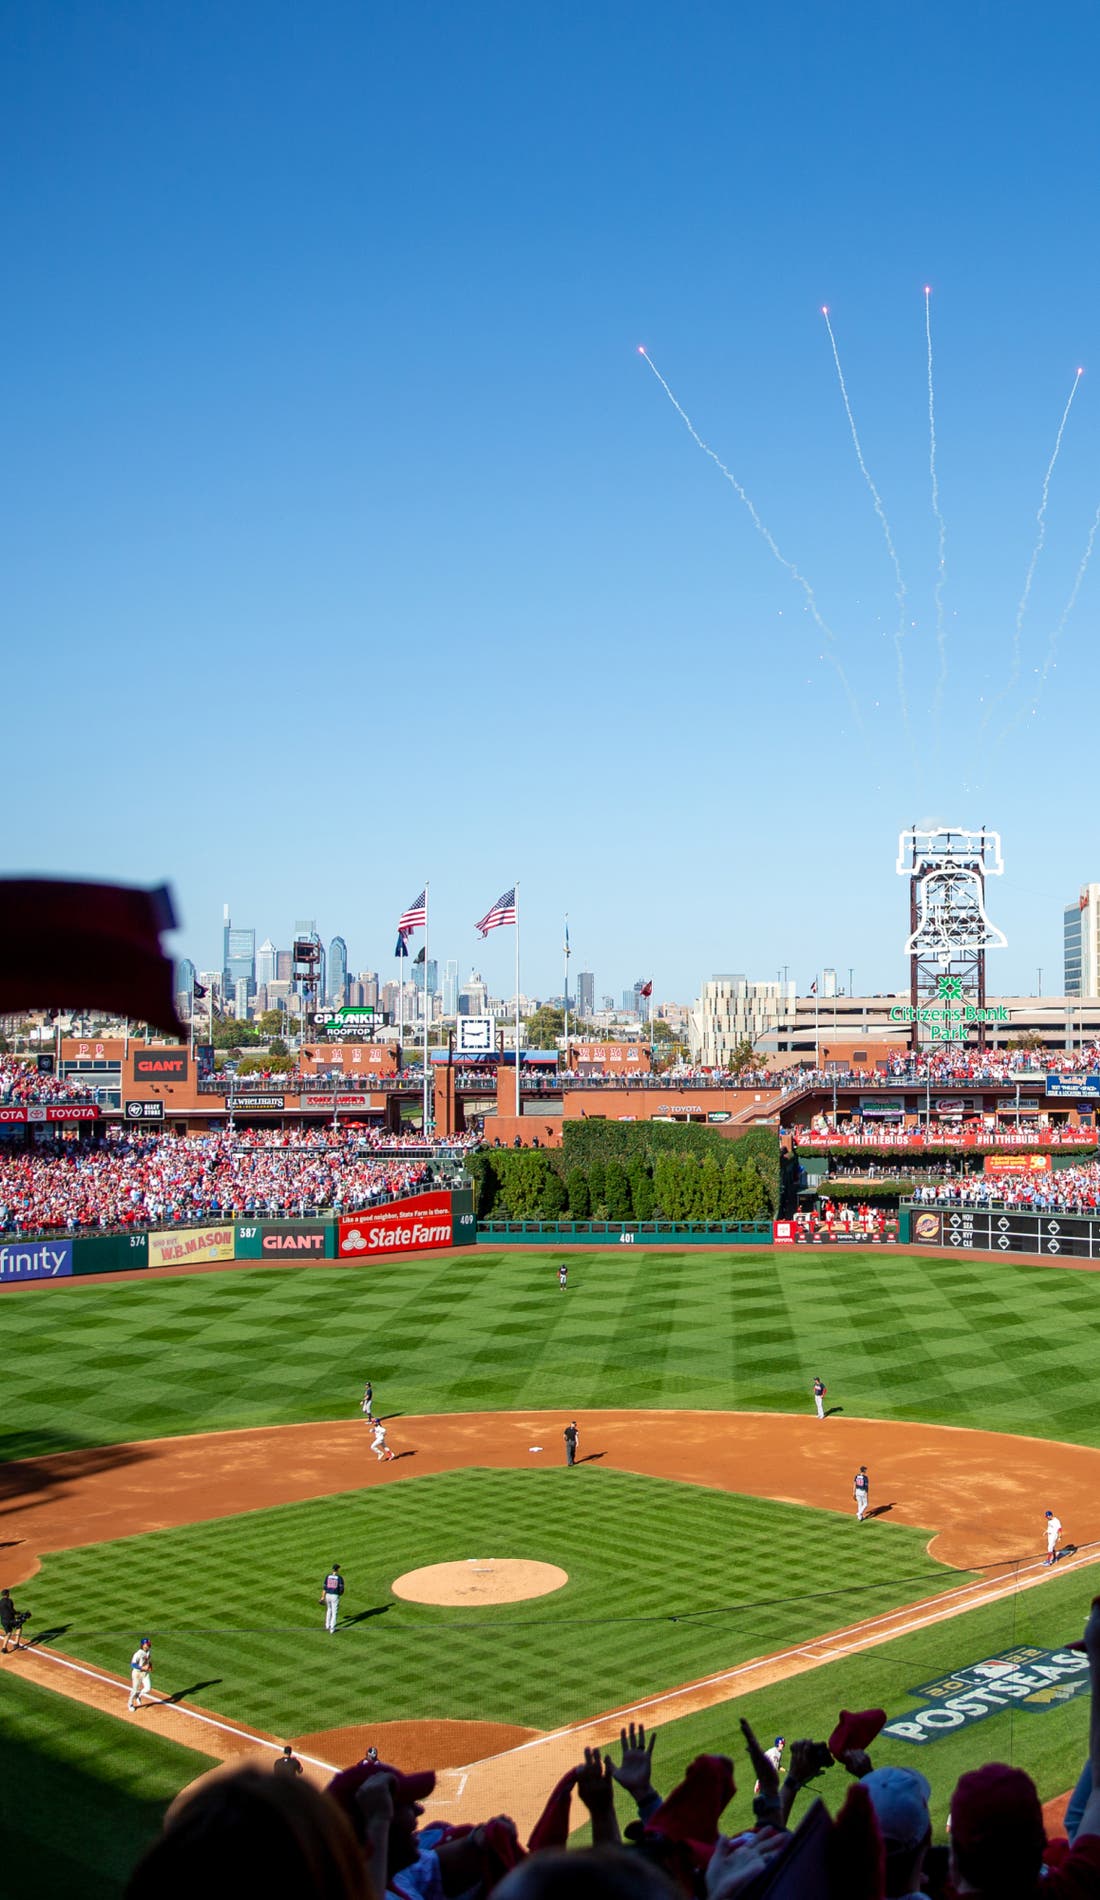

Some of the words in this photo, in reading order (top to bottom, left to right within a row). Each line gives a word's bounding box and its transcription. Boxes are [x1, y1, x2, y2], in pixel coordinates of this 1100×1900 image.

[890, 1006, 961, 1021] Citizens
[965, 1004, 1009, 1021] Bank
[314, 1013, 334, 1024] CP
[334, 1013, 384, 1024] RANKIN
[327, 1028, 371, 1036] ROOFTOP
[931, 1024, 970, 1041] Park
[138, 1060, 184, 1072] GIANT
[50, 1108, 95, 1118] TOYOTA
[670, 1105, 702, 1113] TOYOTA
[848, 1134, 909, 1145] #HITTHEBUDS
[977, 1134, 1040, 1144] #HITTHEBUDS
[342, 1216, 355, 1224] Like
[360, 1215, 373, 1224] good
[374, 1212, 398, 1222] neighbor,
[399, 1210, 413, 1219] State
[414, 1209, 428, 1218] Farm
[460, 1214, 474, 1225] 409
[240, 1227, 257, 1238] 387
[620, 1232, 635, 1243] 401
[129, 1236, 146, 1247] 374
[262, 1235, 324, 1249] GIANT
[0, 1246, 67, 1275] finity
[927, 1681, 964, 1697] 20
